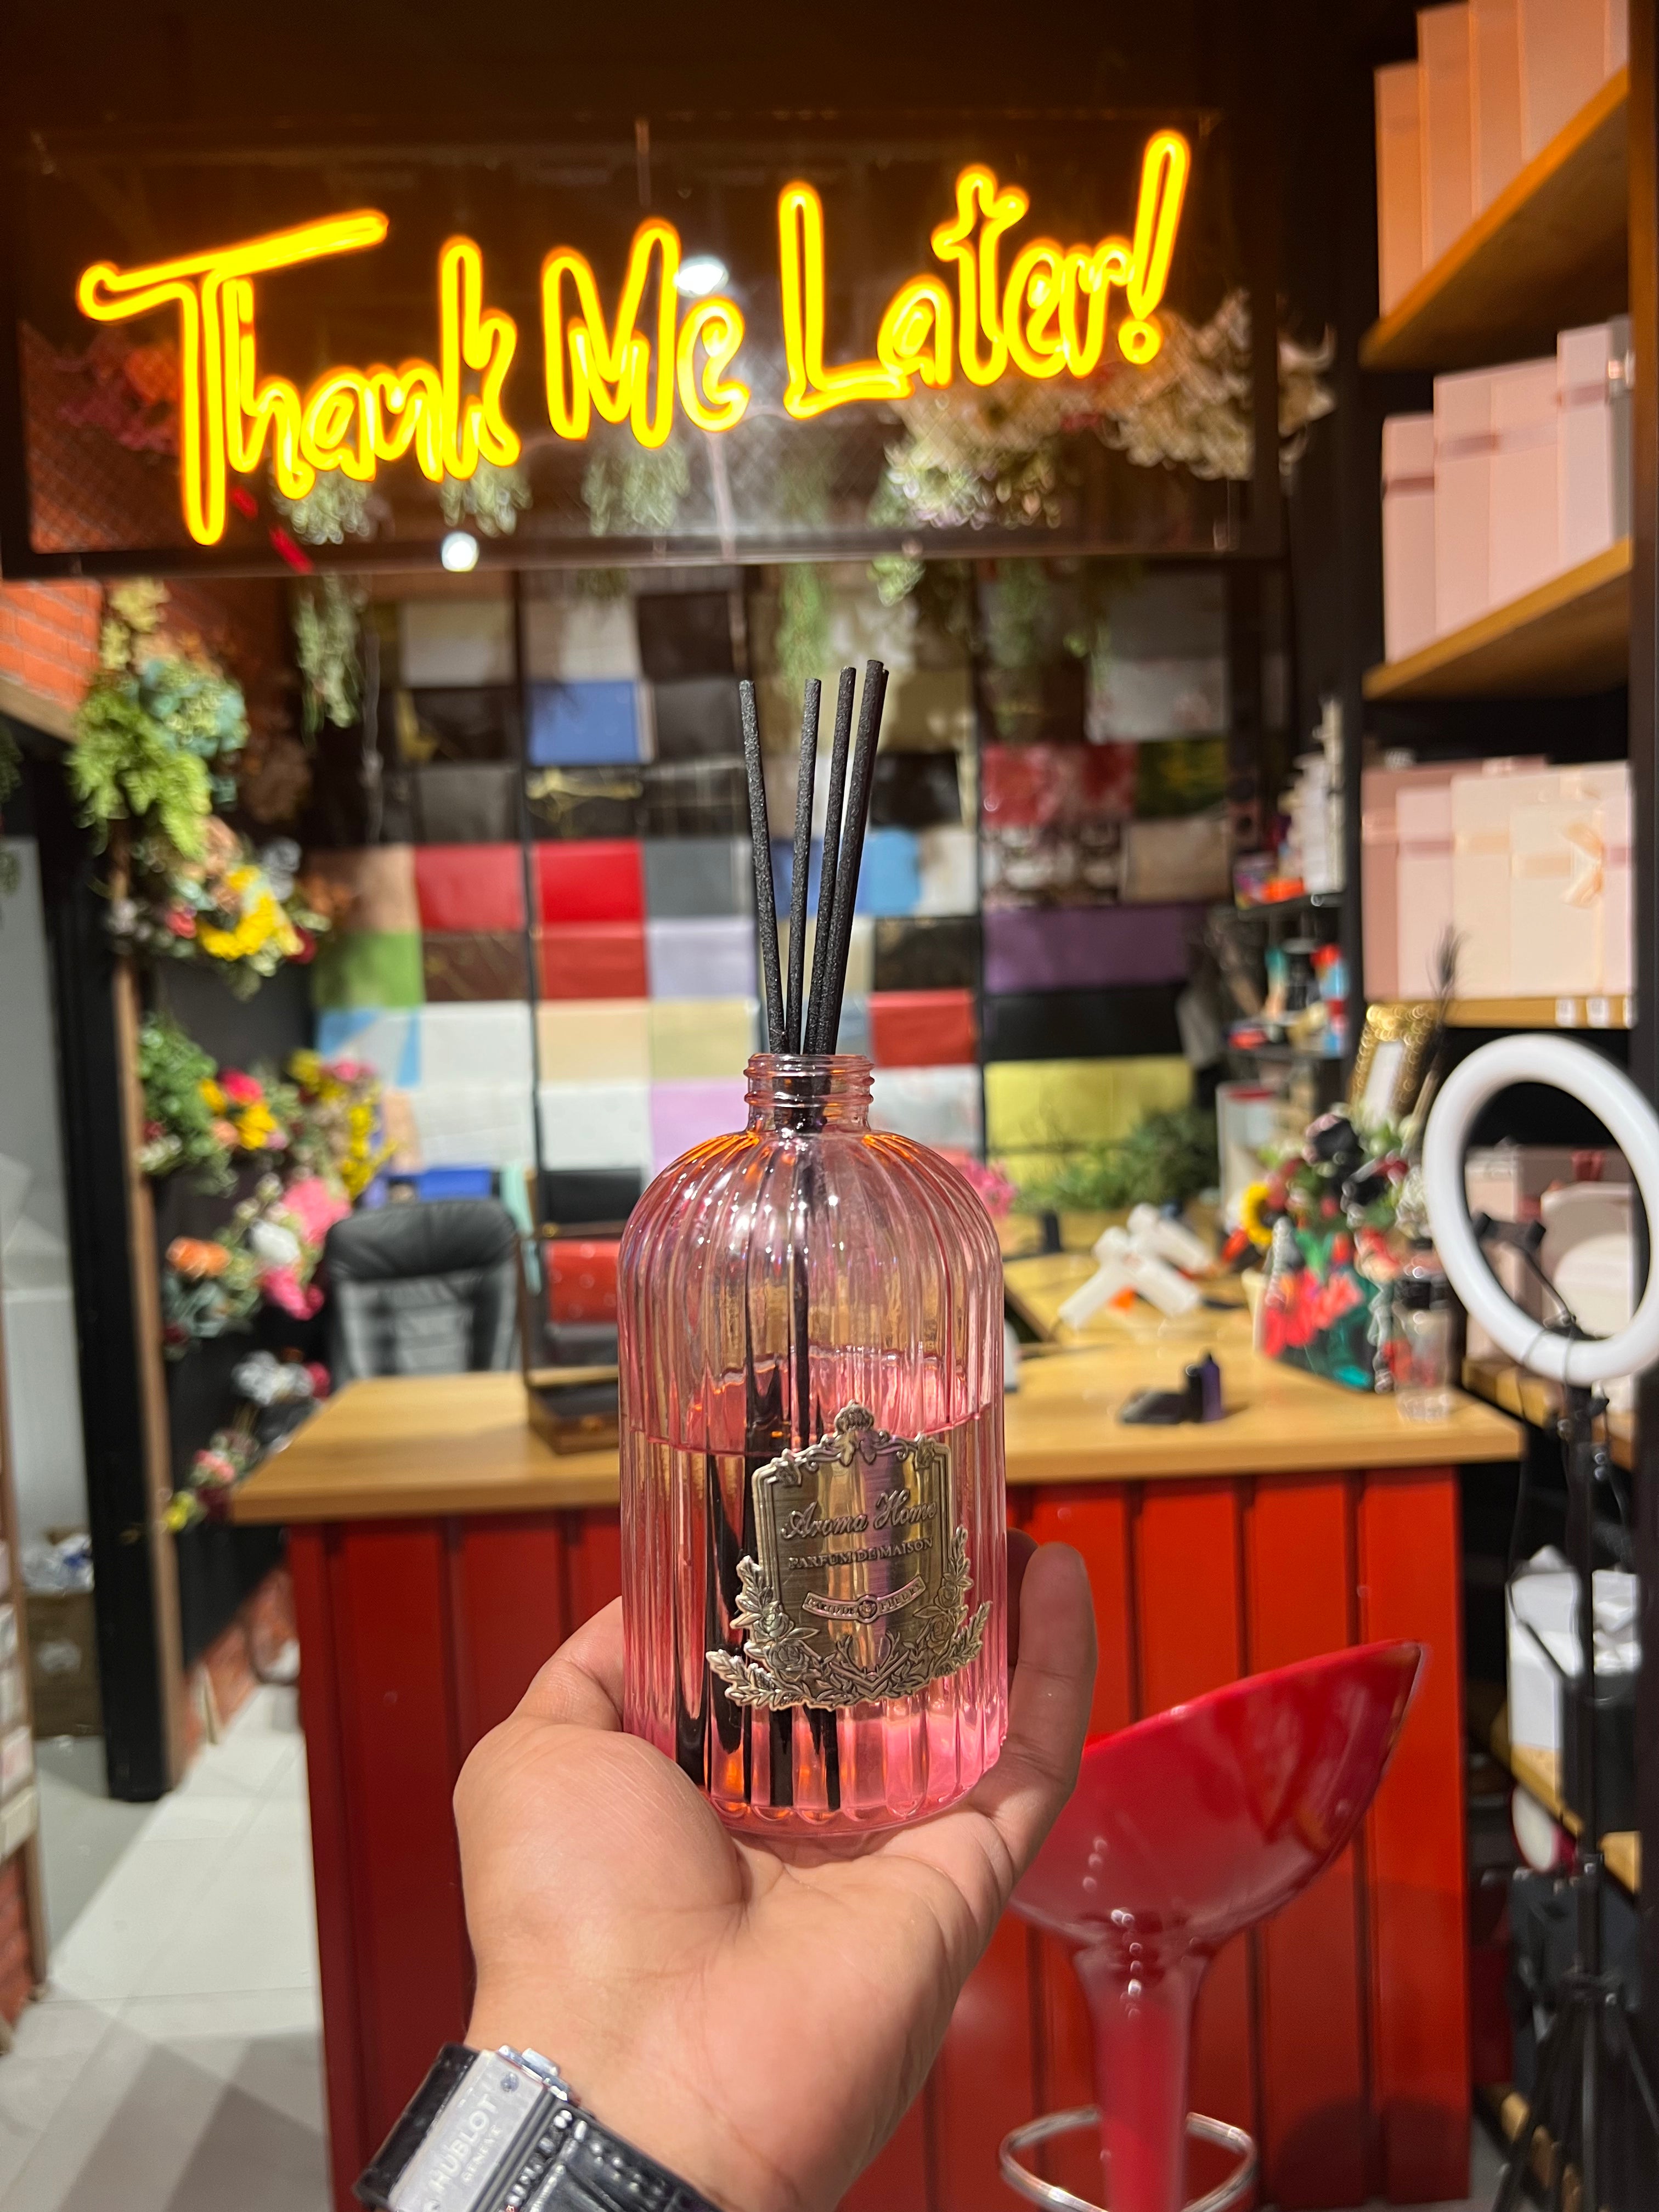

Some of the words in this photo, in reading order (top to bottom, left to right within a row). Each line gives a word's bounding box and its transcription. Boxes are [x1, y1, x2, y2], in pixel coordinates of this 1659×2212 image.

[77, 209, 521, 546] Thank
[542, 217, 752, 449] Me
[778, 128, 1192, 419] Later!
[781, 1501, 868, 1539] Aroma
[874, 1488, 938, 1530] Home
[788, 1551, 852, 1569] PARFUM
[856, 1547, 877, 1561] DE
[879, 1537, 933, 1559] MAISON
[428, 2093, 498, 2194] HUBLOT
